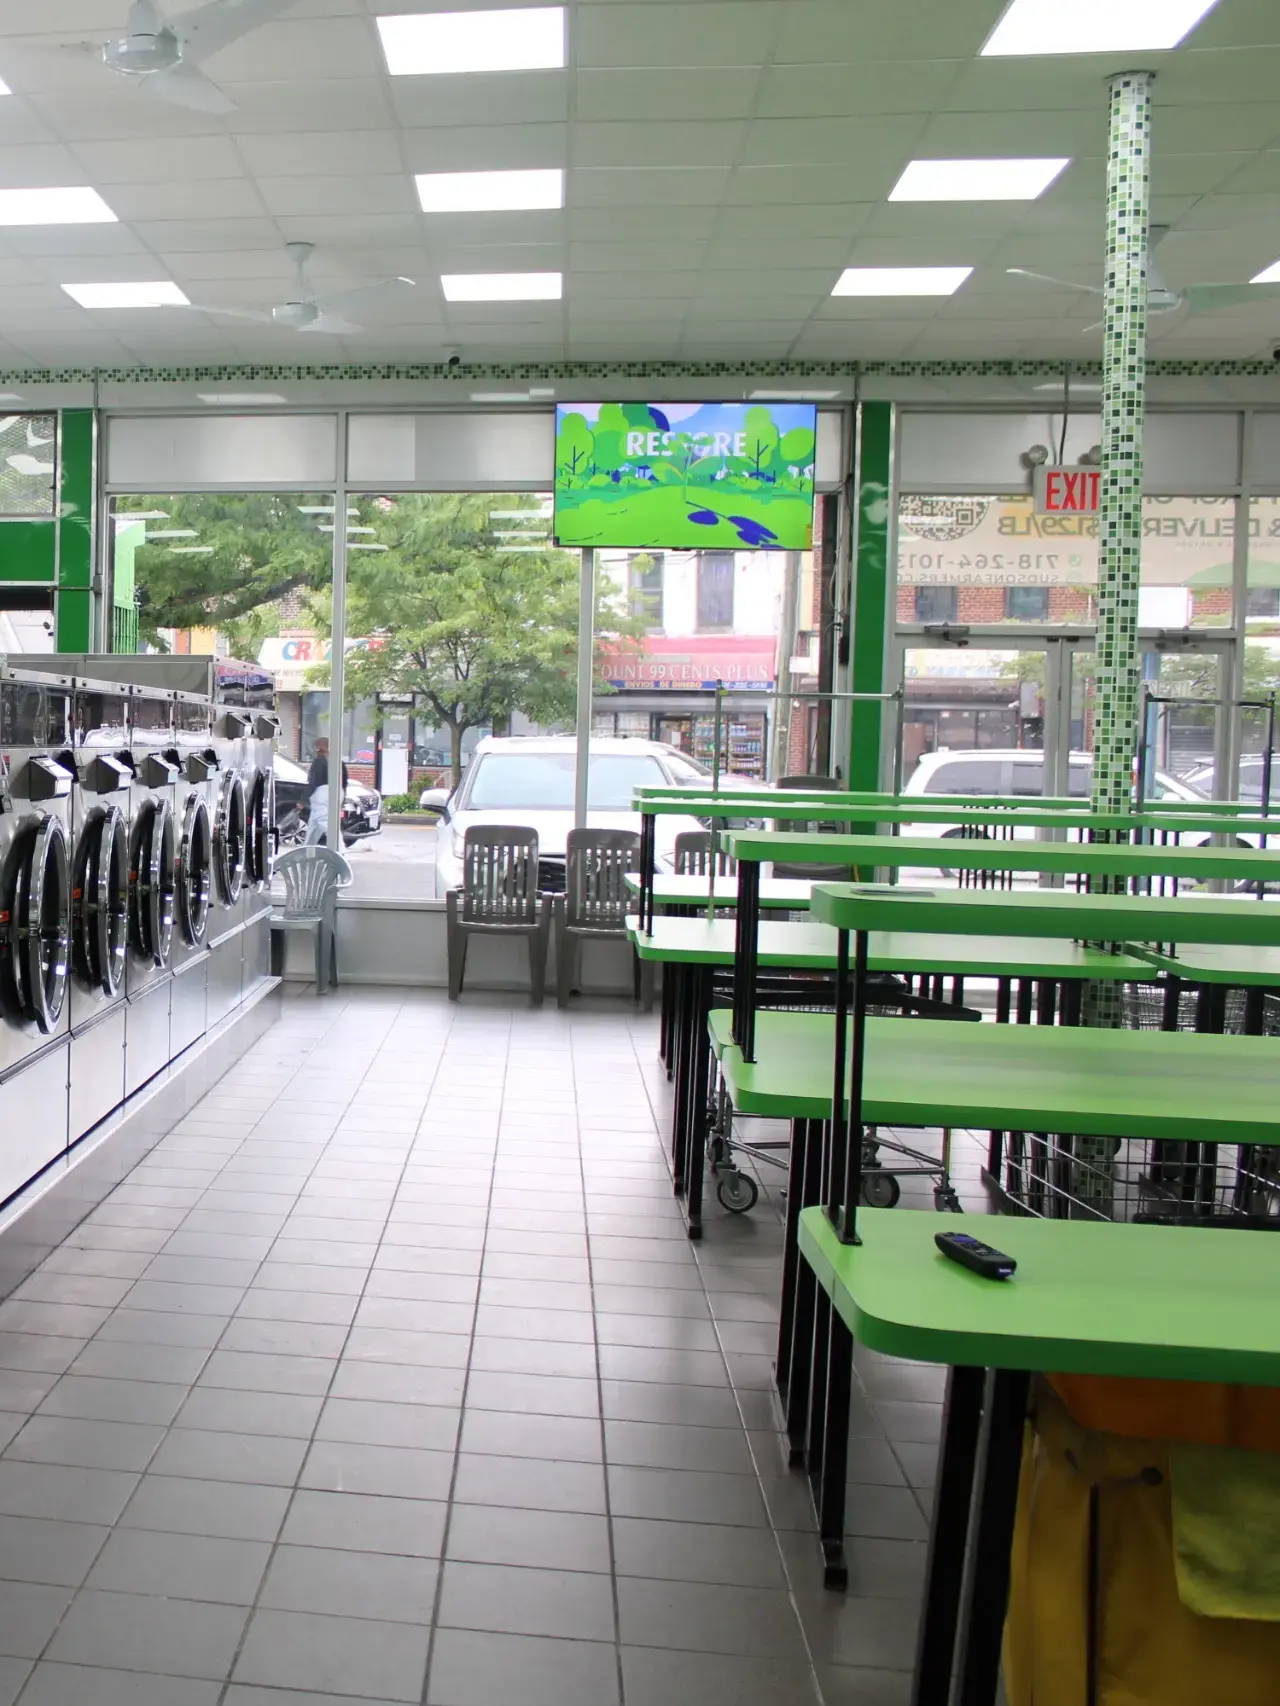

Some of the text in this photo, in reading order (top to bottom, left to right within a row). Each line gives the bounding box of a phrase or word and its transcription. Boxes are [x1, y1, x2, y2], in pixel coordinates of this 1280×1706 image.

[626, 431, 747, 457] RESORE
[1046, 472, 1099, 511] EXIT
[600, 663, 768, 679] OUNT 99 CENTS PLUS
